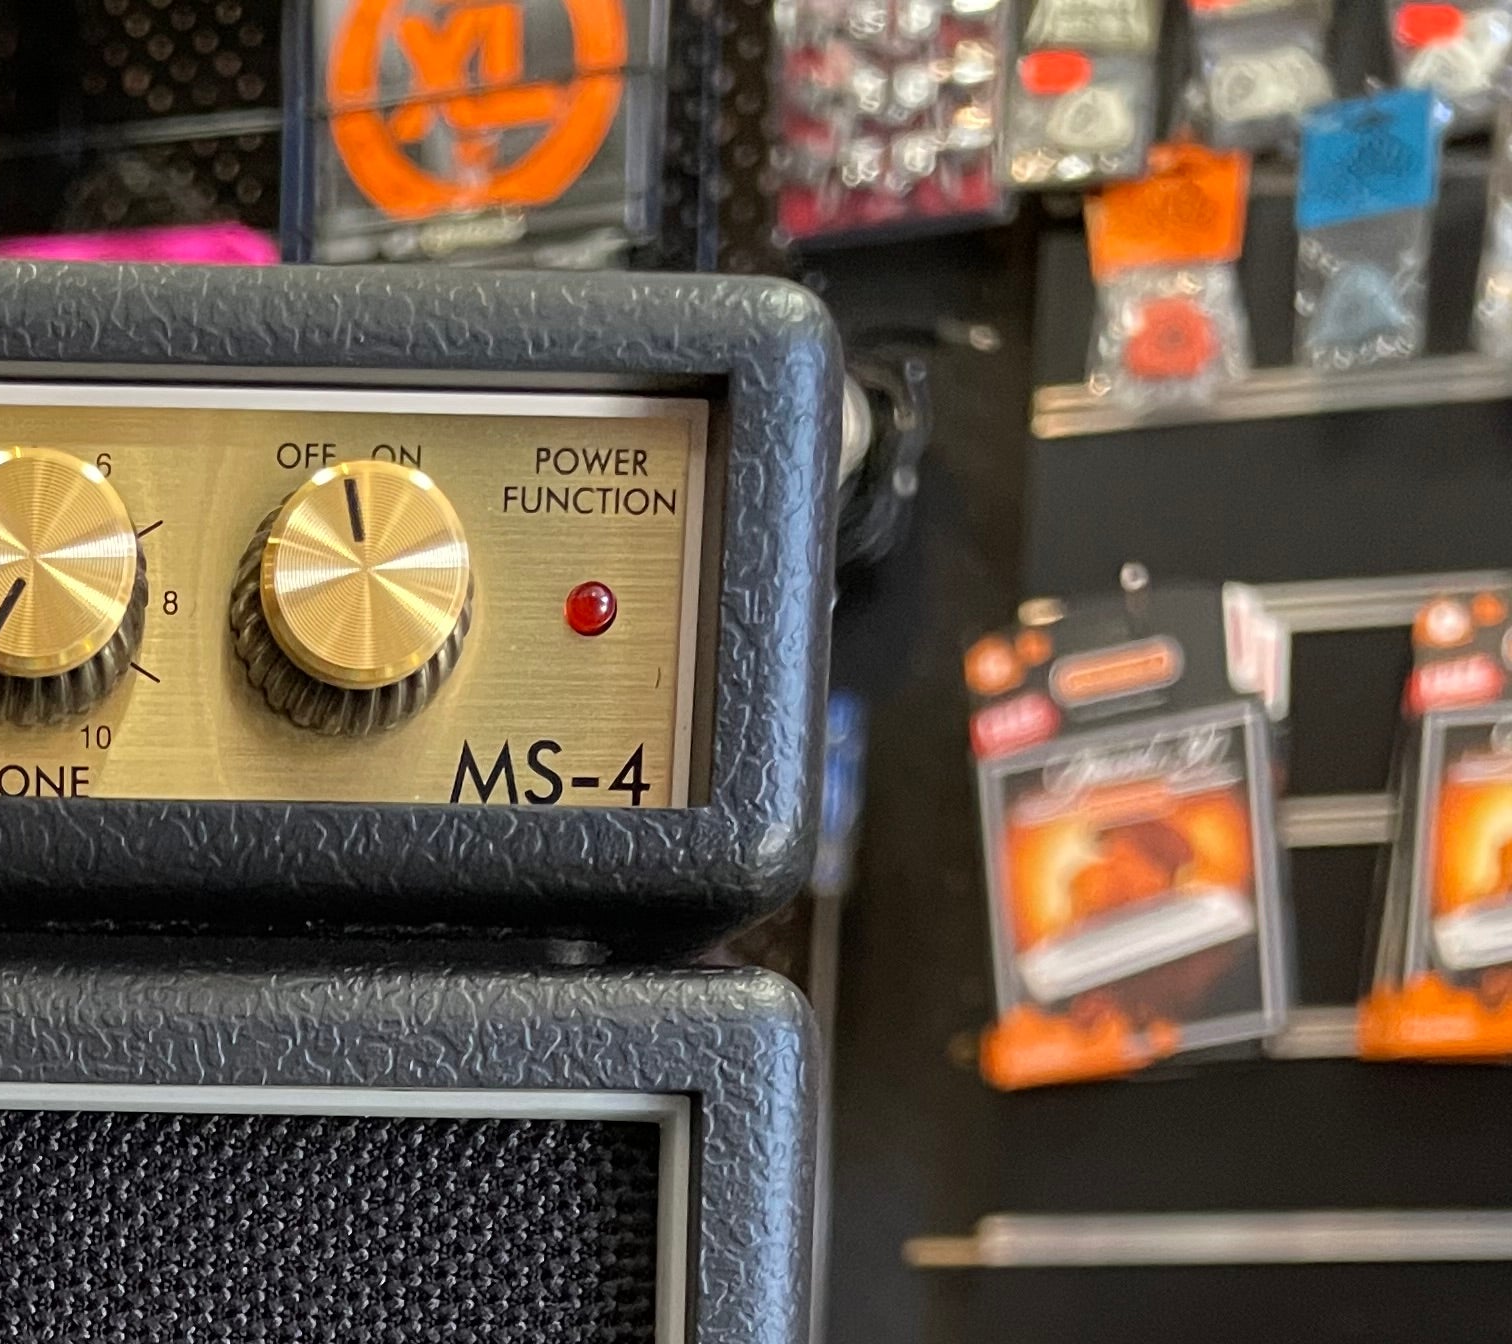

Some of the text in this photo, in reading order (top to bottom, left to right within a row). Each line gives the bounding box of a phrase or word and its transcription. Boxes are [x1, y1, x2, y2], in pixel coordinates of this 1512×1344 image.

[96, 453, 112, 477] 6
[277, 442, 421, 469] OFF ON
[536, 447, 648, 477] POWER
[503, 486, 677, 516] FUNCTION
[163, 590, 178, 616] 8
[81, 725, 111, 750] 10
[449, 738, 651, 806] MS-4
